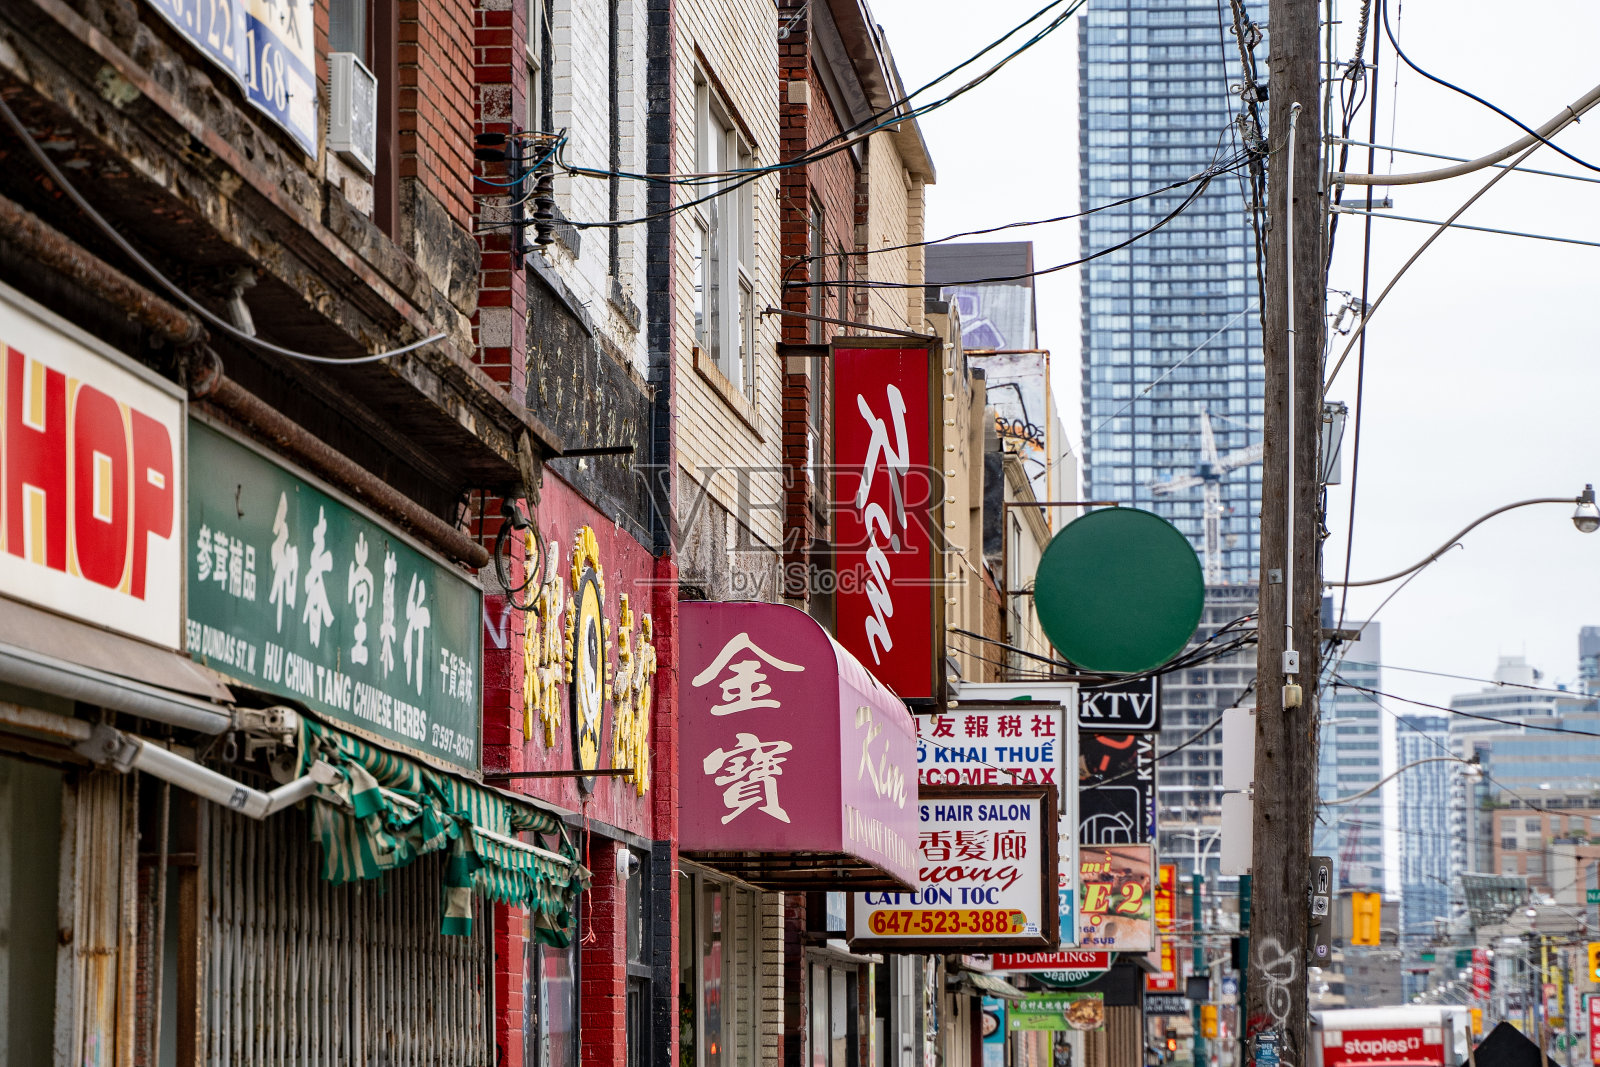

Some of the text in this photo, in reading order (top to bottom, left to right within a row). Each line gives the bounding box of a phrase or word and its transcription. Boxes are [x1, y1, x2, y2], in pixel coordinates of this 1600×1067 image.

[856, 383, 910, 666] Kim
[202, 624, 236, 666] DUNDAS
[262, 641, 427, 743] HU CHUN TANG CHINESE HERBS
[1080, 691, 1152, 719] KTV
[439, 725, 474, 762] 597-8367
[934, 746, 987, 763] KHAI
[994, 738, 1056, 763] THUẾ
[855, 705, 908, 810] Kim
[1136, 739, 1153, 781] KTV
[1006, 767, 1056, 785] TAX
[935, 804, 973, 822] HAIR
[977, 803, 1031, 821] SALON
[957, 884, 999, 905] TÓC
[1092, 936, 1115, 945] SUB
[1017, 952, 1097, 964] DUMPLINGS
[1344, 1038, 1408, 1056] staples
